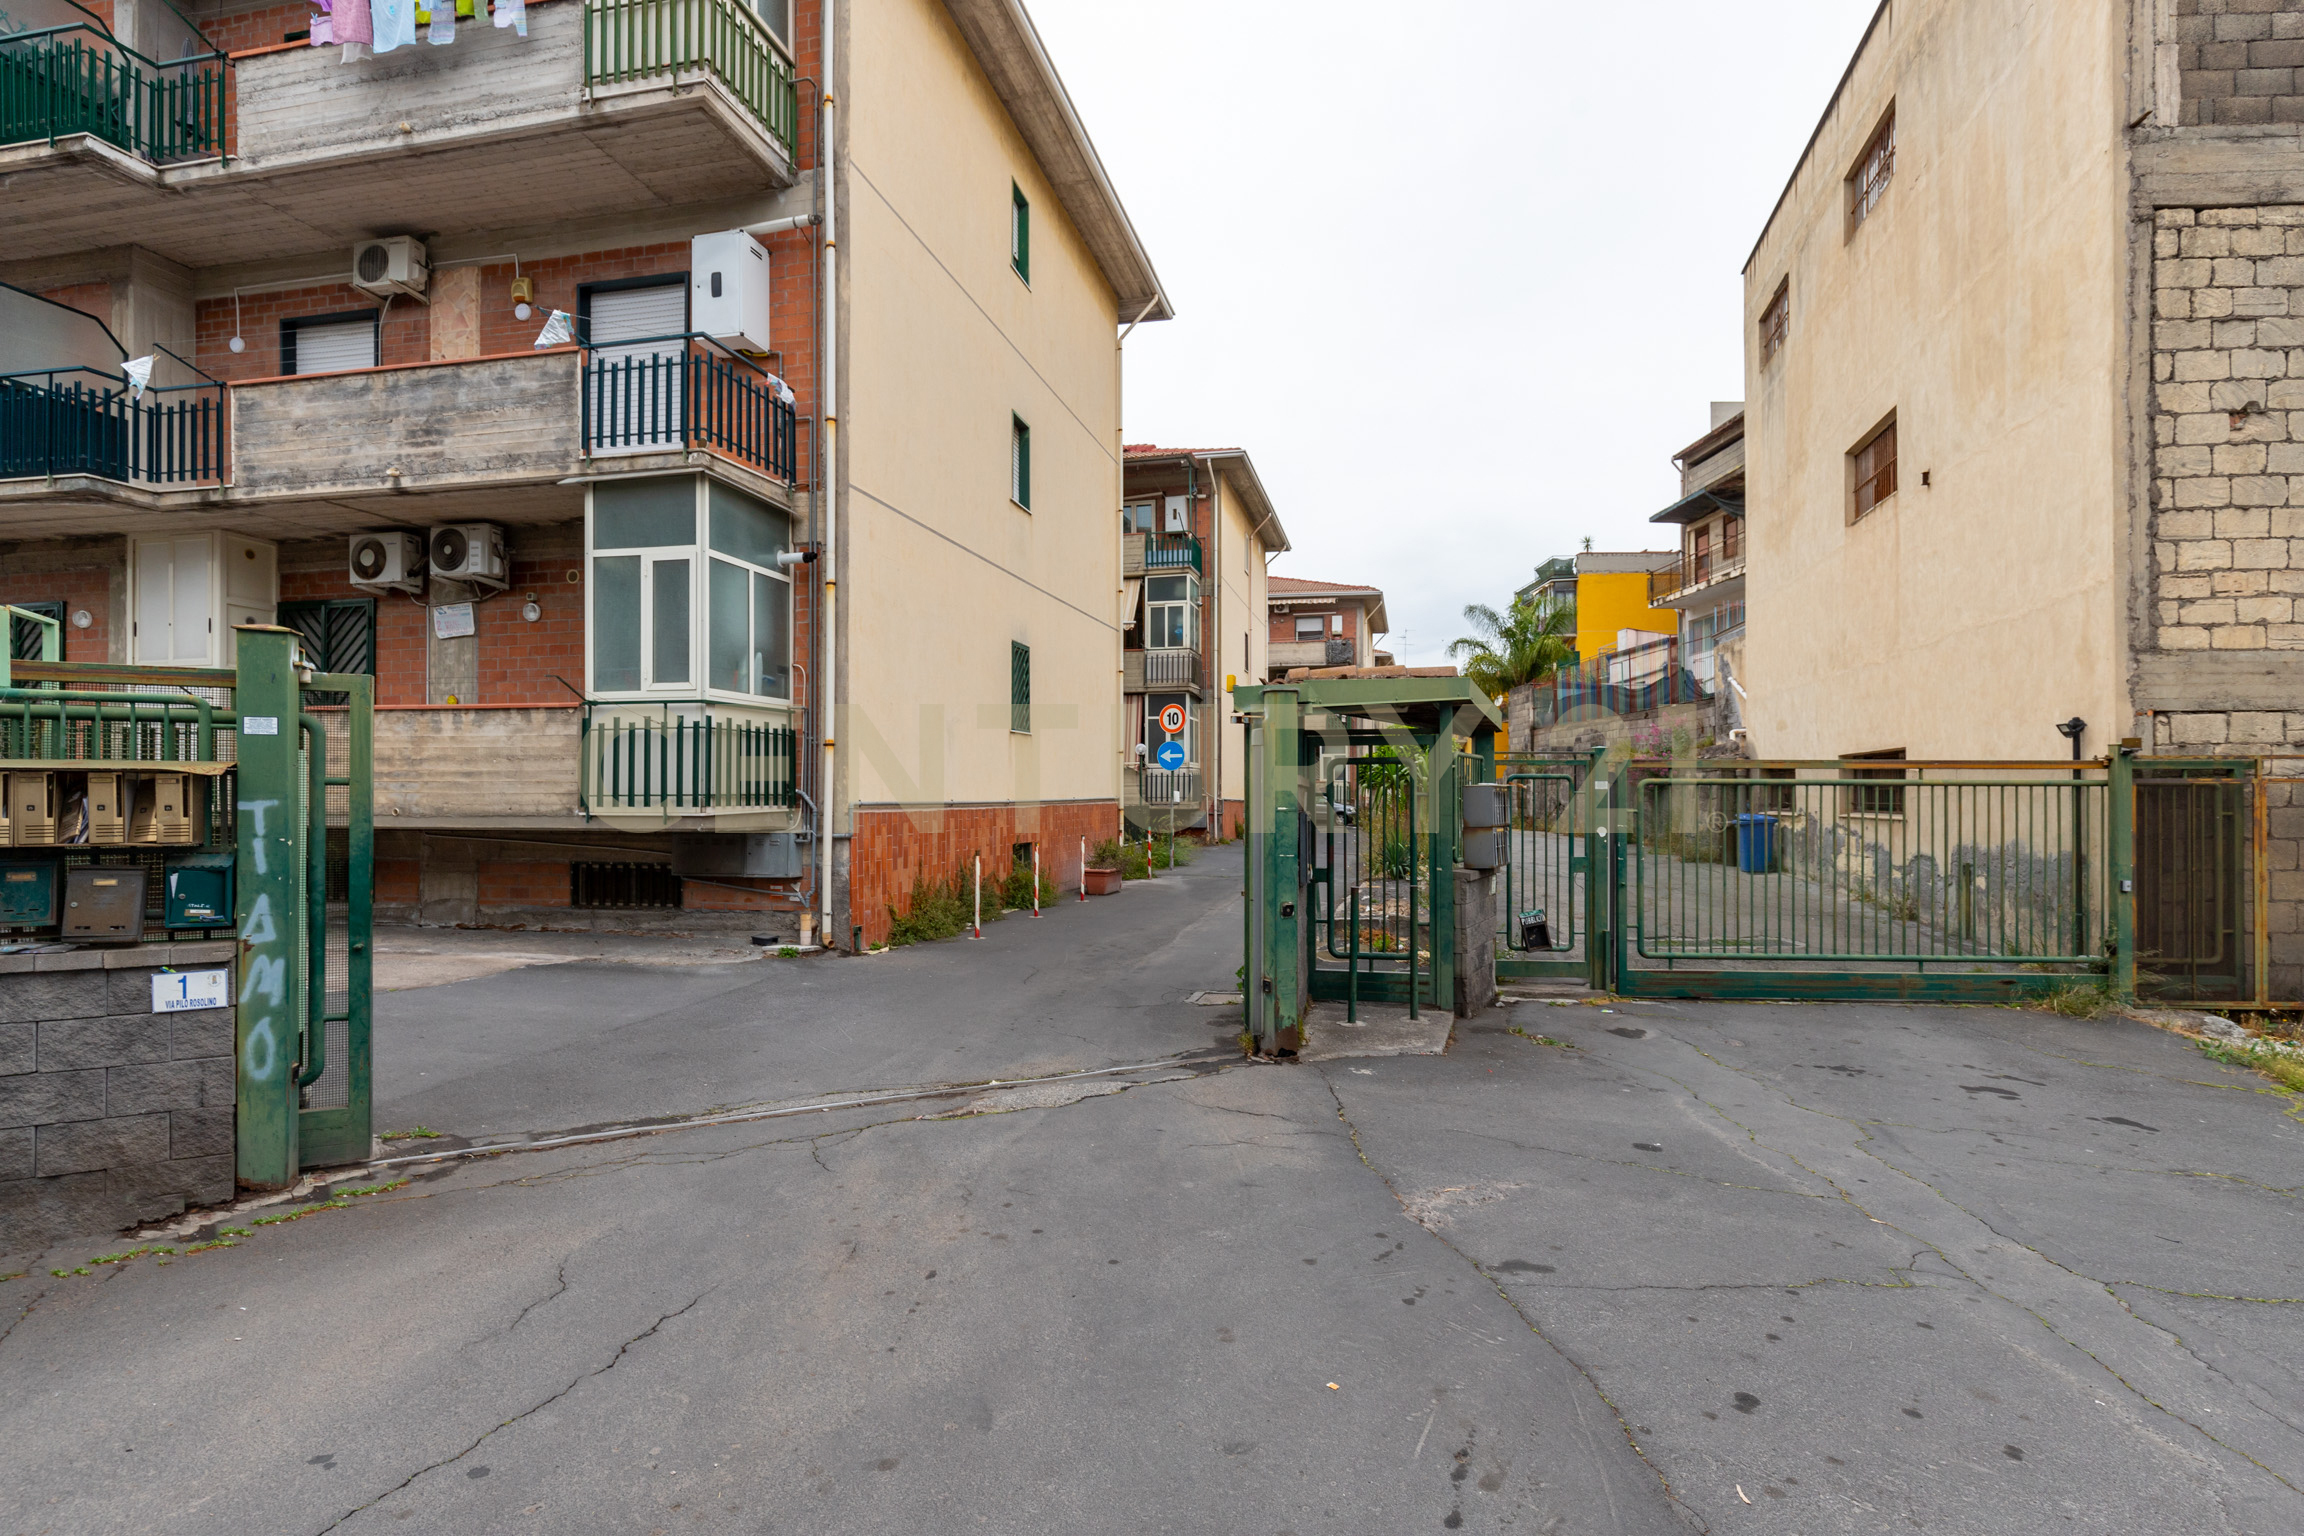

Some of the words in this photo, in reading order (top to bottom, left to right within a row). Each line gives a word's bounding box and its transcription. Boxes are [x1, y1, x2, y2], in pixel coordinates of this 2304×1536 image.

[1166, 712, 1179, 725] 10
[178, 975, 187, 999] 1
[165, 1000, 175, 1009] VIA
[176, 999, 188, 1008] PILO
[190, 997, 217, 1007] ROSOLINO
